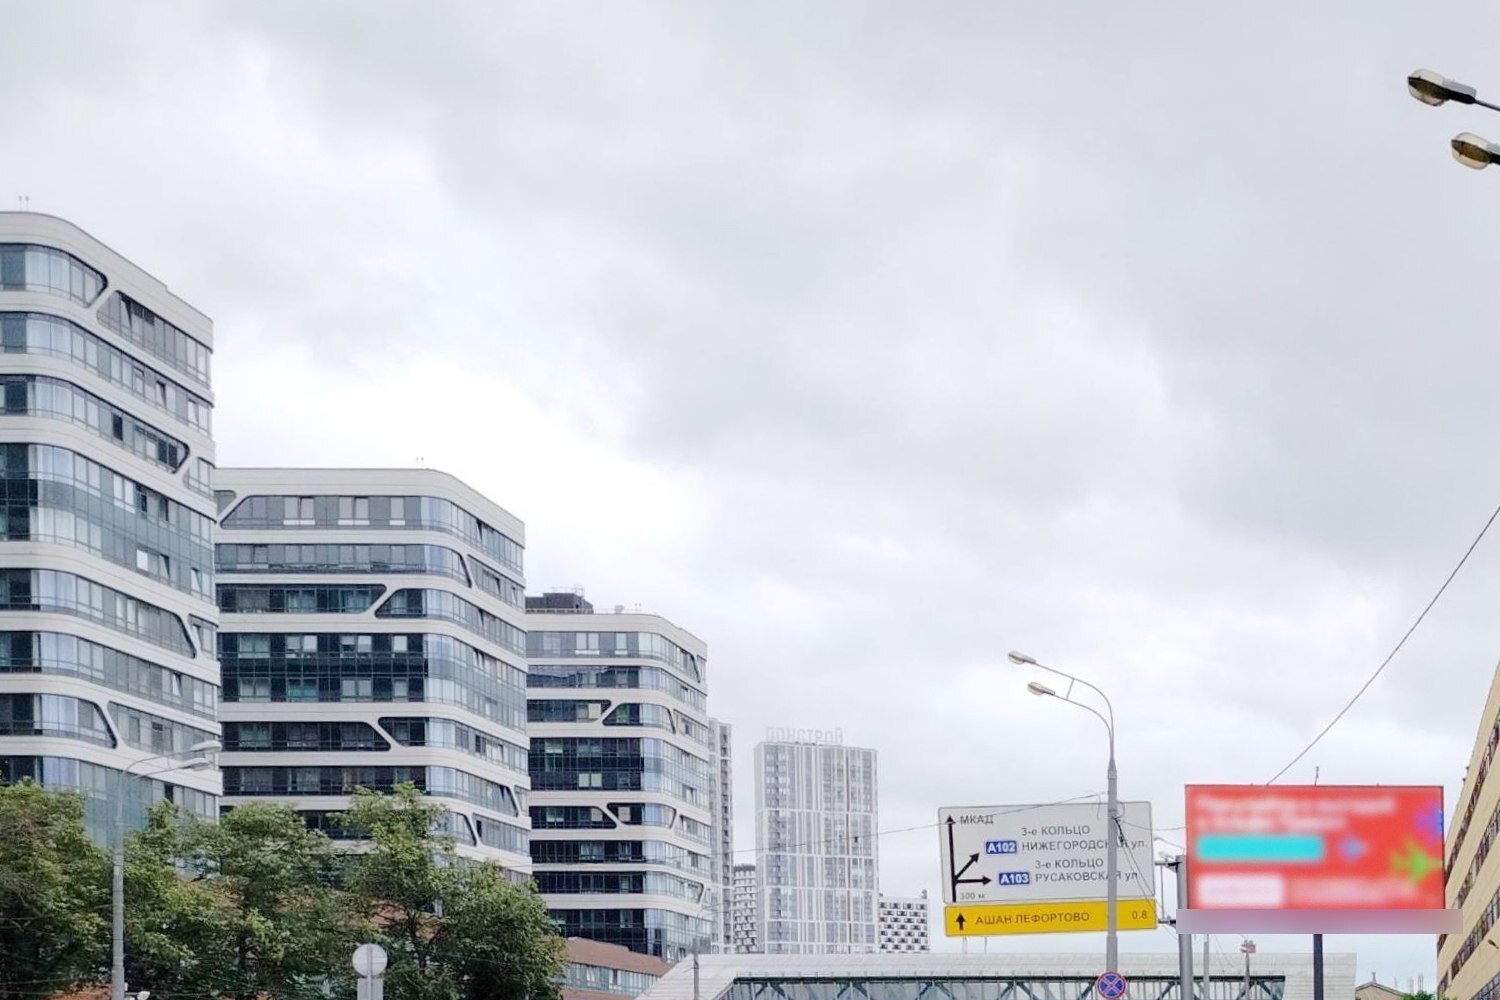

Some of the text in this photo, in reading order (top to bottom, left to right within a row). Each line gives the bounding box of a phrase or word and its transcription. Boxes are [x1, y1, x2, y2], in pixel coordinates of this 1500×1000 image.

[960, 814, 994, 826] МКАД
[1041, 825, 1090, 837] КОЛЬЦО
[1022, 839, 1128, 851] НИЖЕГОРОДСЯ
[1054, 858, 1104, 870] КОЛЬЦО
[976, 912, 1090, 925] АШАН ЛЕФОРТОВО
